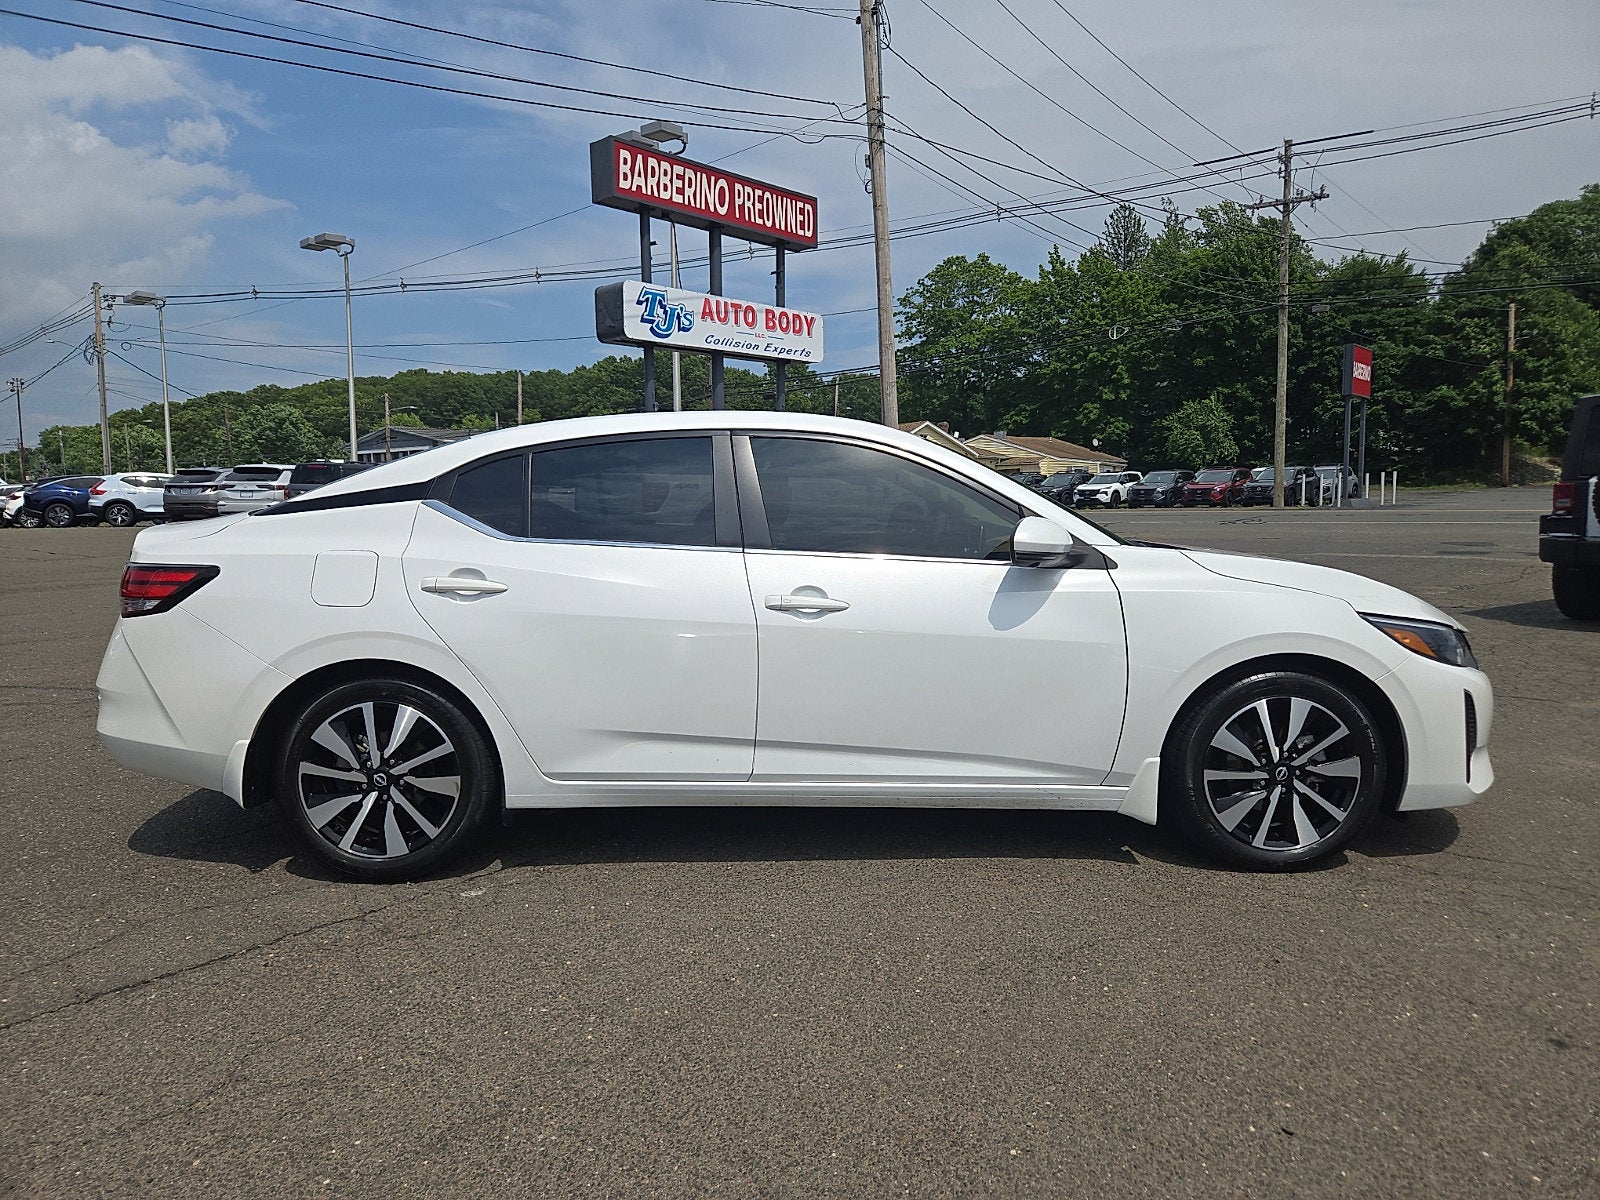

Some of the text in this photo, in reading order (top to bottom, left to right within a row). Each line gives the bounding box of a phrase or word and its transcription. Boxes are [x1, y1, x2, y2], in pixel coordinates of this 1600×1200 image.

[619, 149, 813, 237] BARBERINO PREOWNED
[636, 286, 694, 339] TJ's
[701, 297, 816, 338] AUTO BODY
[705, 334, 812, 358] Collision Experts
